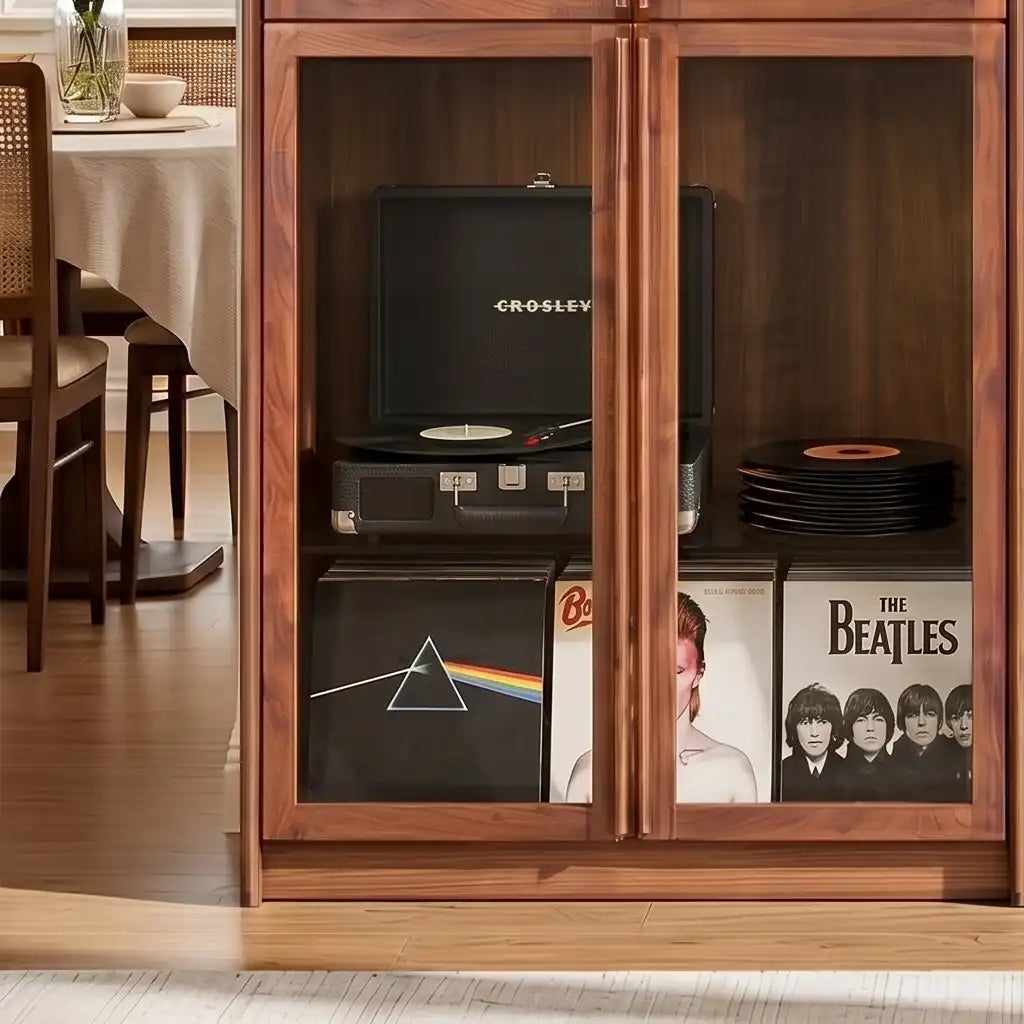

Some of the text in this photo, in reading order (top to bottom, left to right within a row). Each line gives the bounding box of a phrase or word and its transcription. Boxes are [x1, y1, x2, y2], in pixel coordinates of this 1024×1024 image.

[496, 299, 592, 313] CROSLEY
[879, 597, 908, 613] THE
[828, 599, 959, 665] BEATLES
